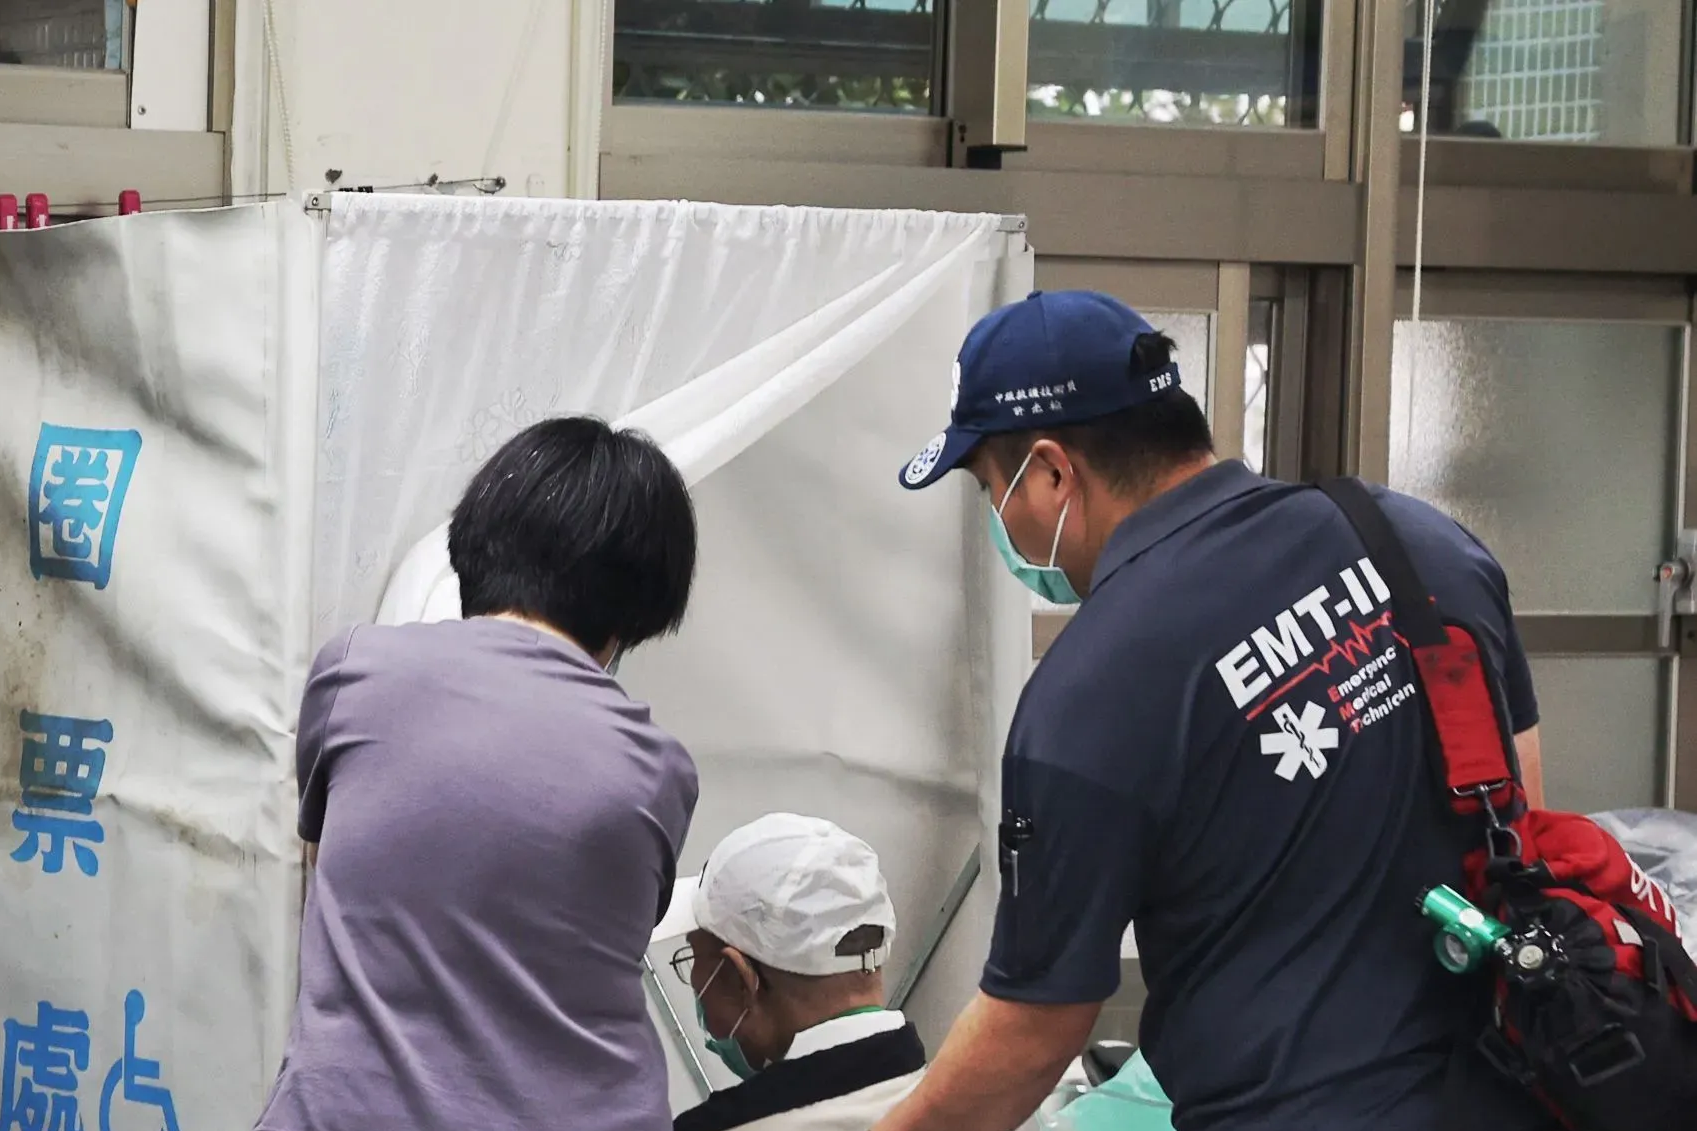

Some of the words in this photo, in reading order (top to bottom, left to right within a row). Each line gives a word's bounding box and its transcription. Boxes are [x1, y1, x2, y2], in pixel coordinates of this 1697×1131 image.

[1148, 371, 1173, 393] EMS
[1215, 556, 1391, 709] EMT-II
[1338, 673, 1392, 721] Medcal
